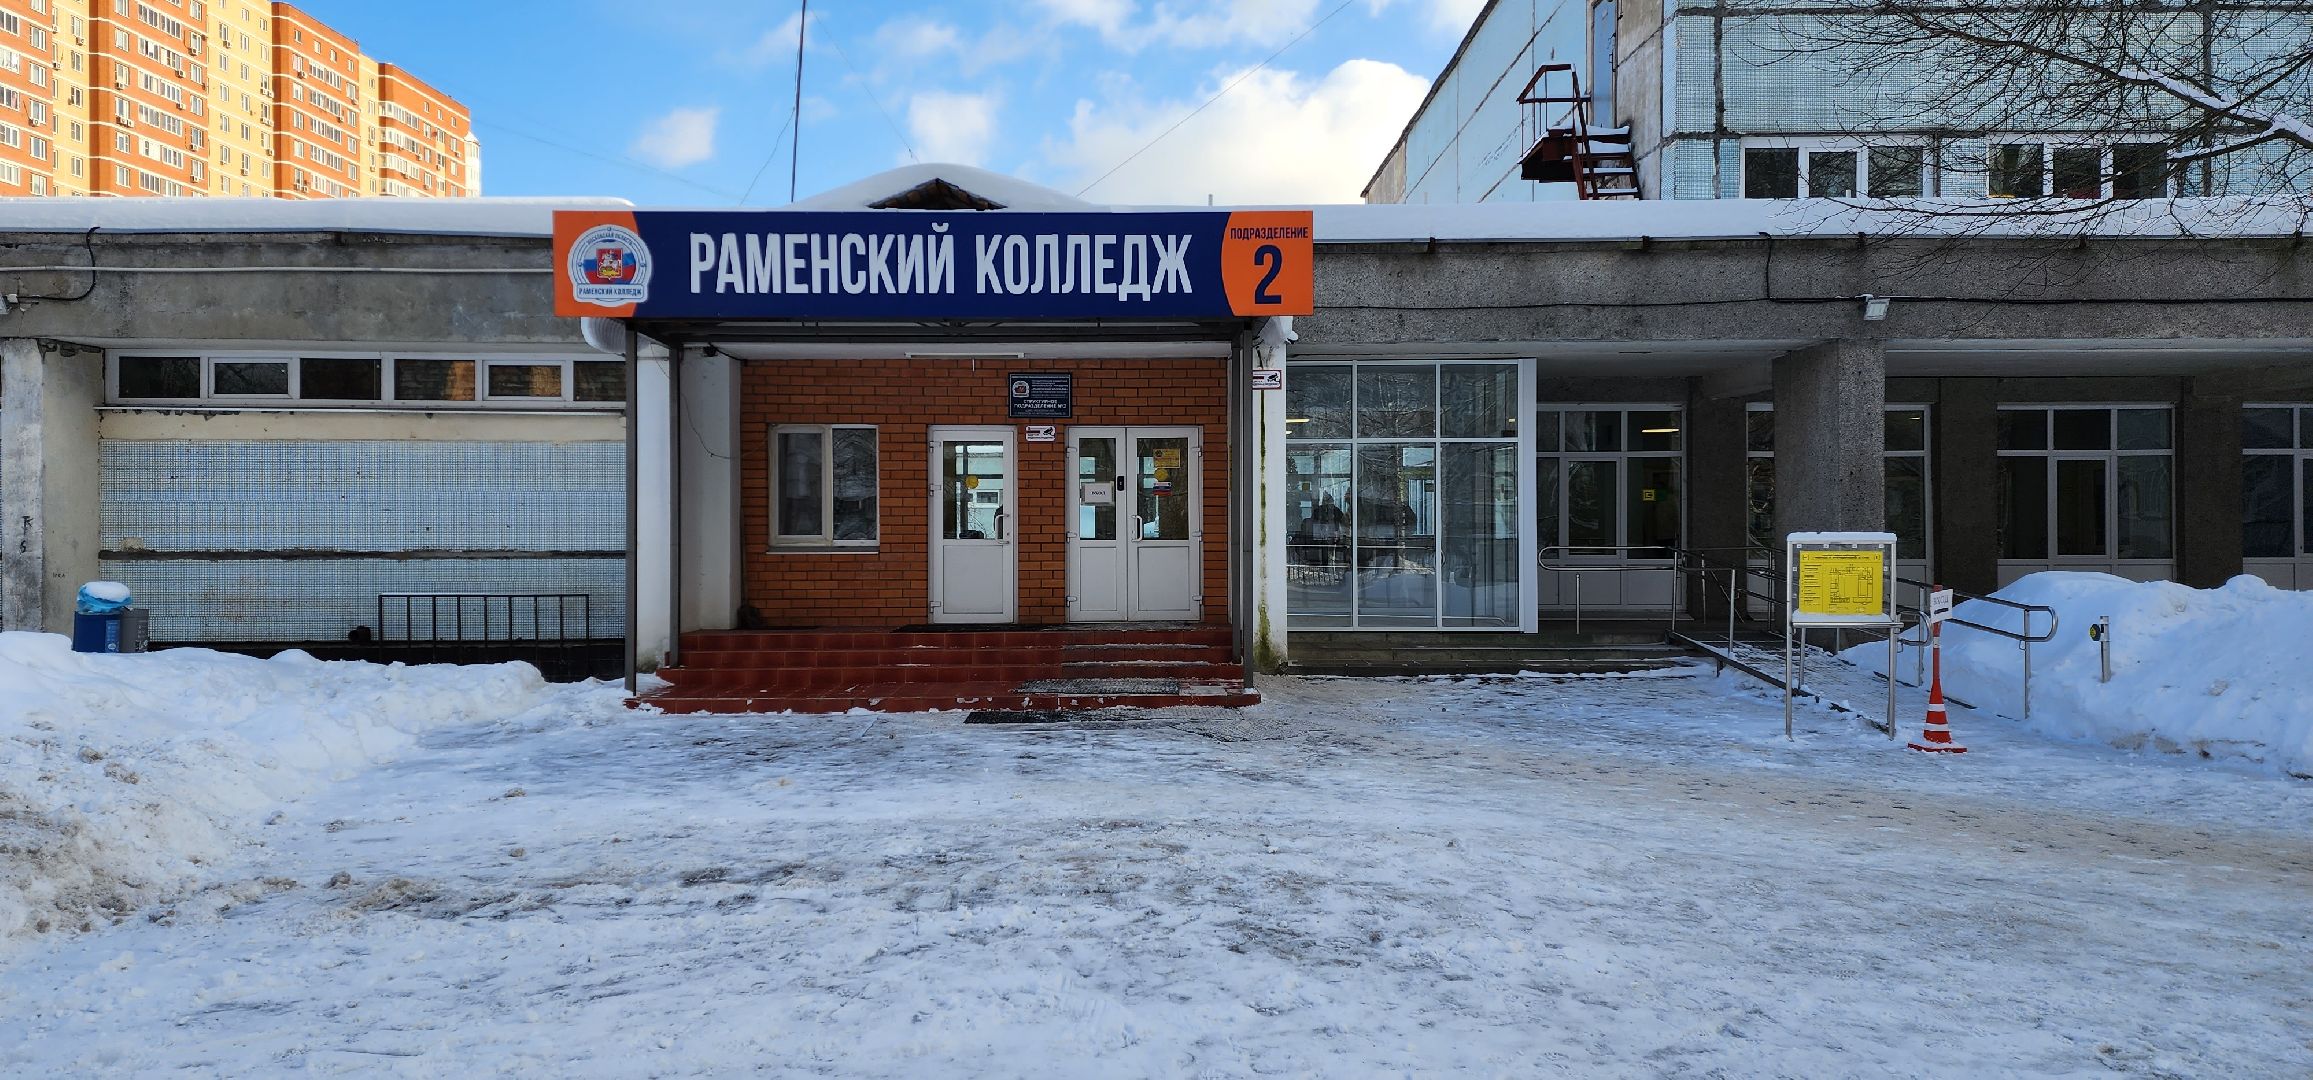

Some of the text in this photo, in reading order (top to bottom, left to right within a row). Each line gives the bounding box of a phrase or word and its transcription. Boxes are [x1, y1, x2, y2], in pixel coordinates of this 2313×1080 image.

[1230, 226, 1309, 241] ПОДРАЗДЕЛЕНИЕ
[689, 222, 1193, 302] РАМЕНСКИЙ КОЛЛЕДЖ
[1253, 244, 1283, 305] 2
[578, 286, 642, 296] РАМЕНСКИЙ КОЛЛЕДЖ
